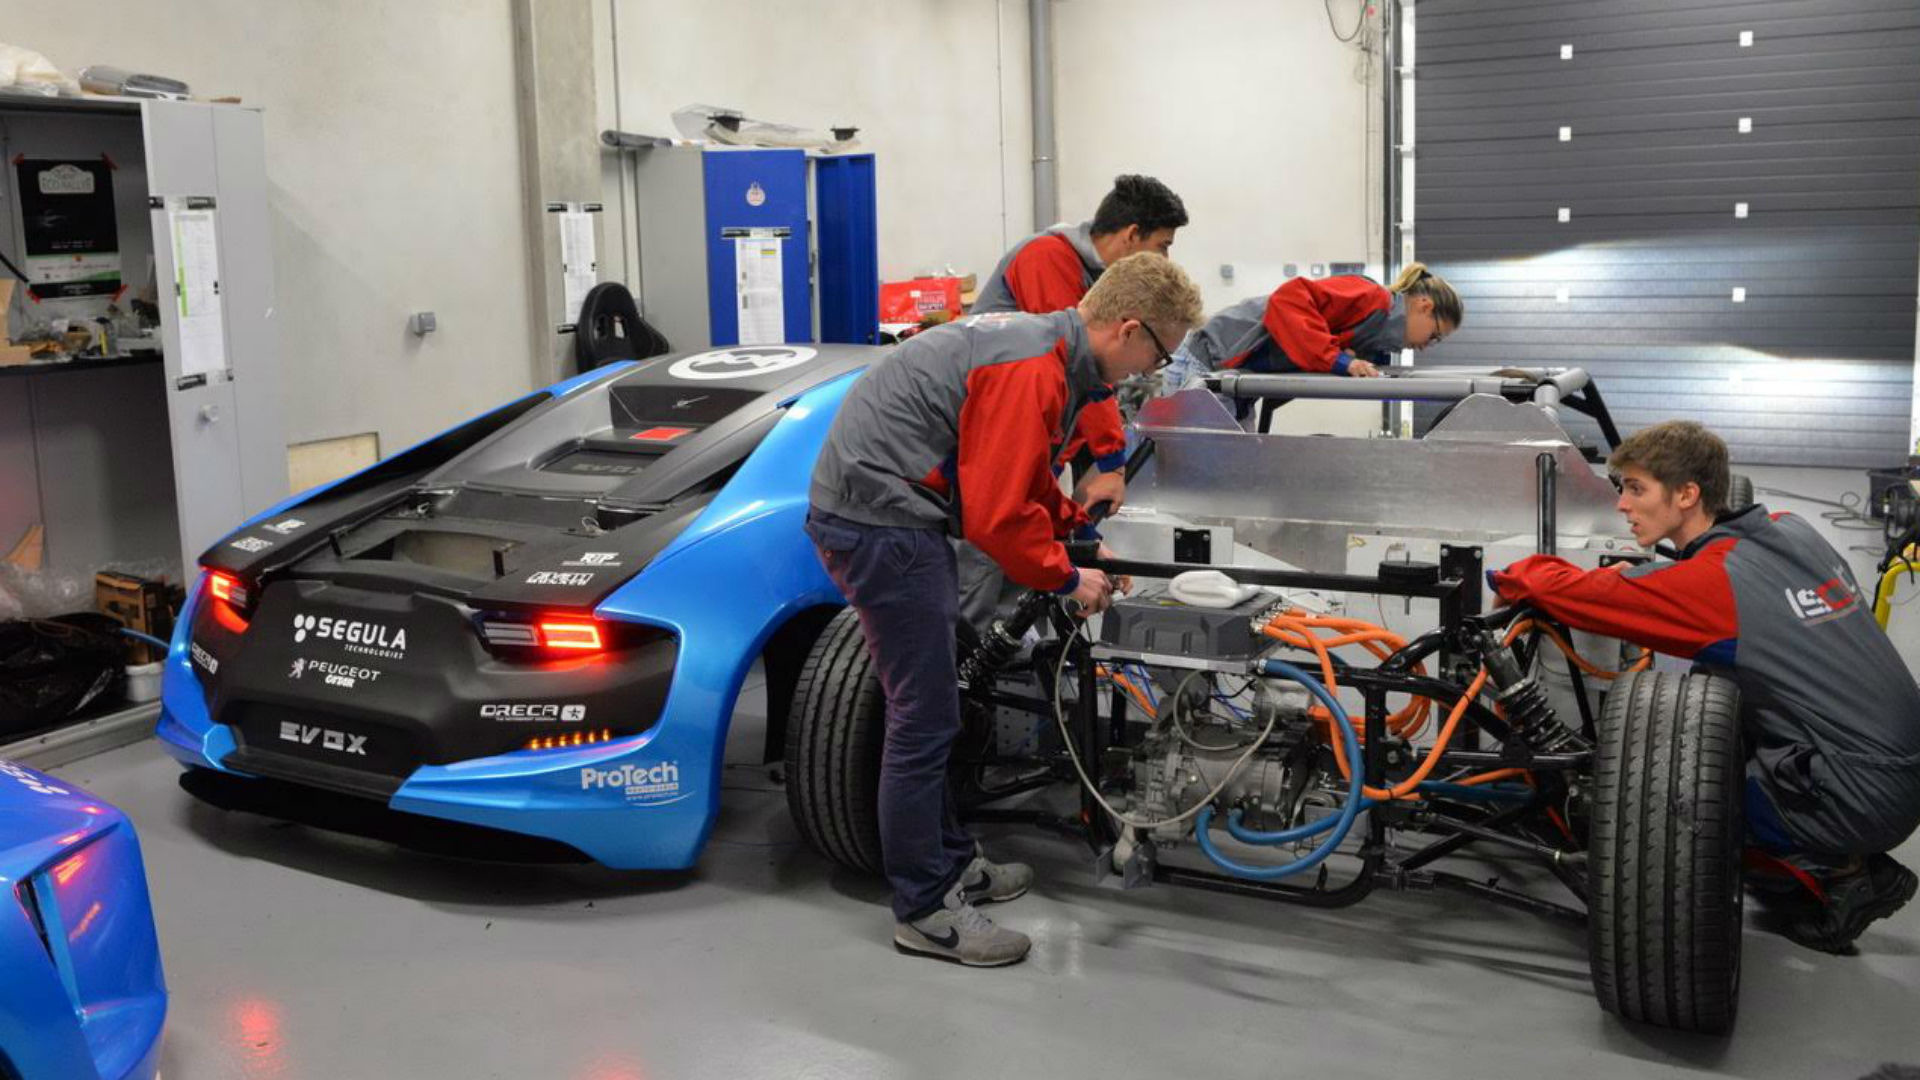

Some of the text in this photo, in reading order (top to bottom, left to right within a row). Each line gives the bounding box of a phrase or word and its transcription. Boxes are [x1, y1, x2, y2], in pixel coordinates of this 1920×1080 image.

[316, 617, 406, 650] SEGULA
[344, 643, 404, 660] TECHNOLOGIES
[308, 660, 381, 681] PEUGEOT
[480, 704, 559, 718] ORECA
[279, 721, 368, 756] EVOX
[581, 761, 679, 790] ProTech
